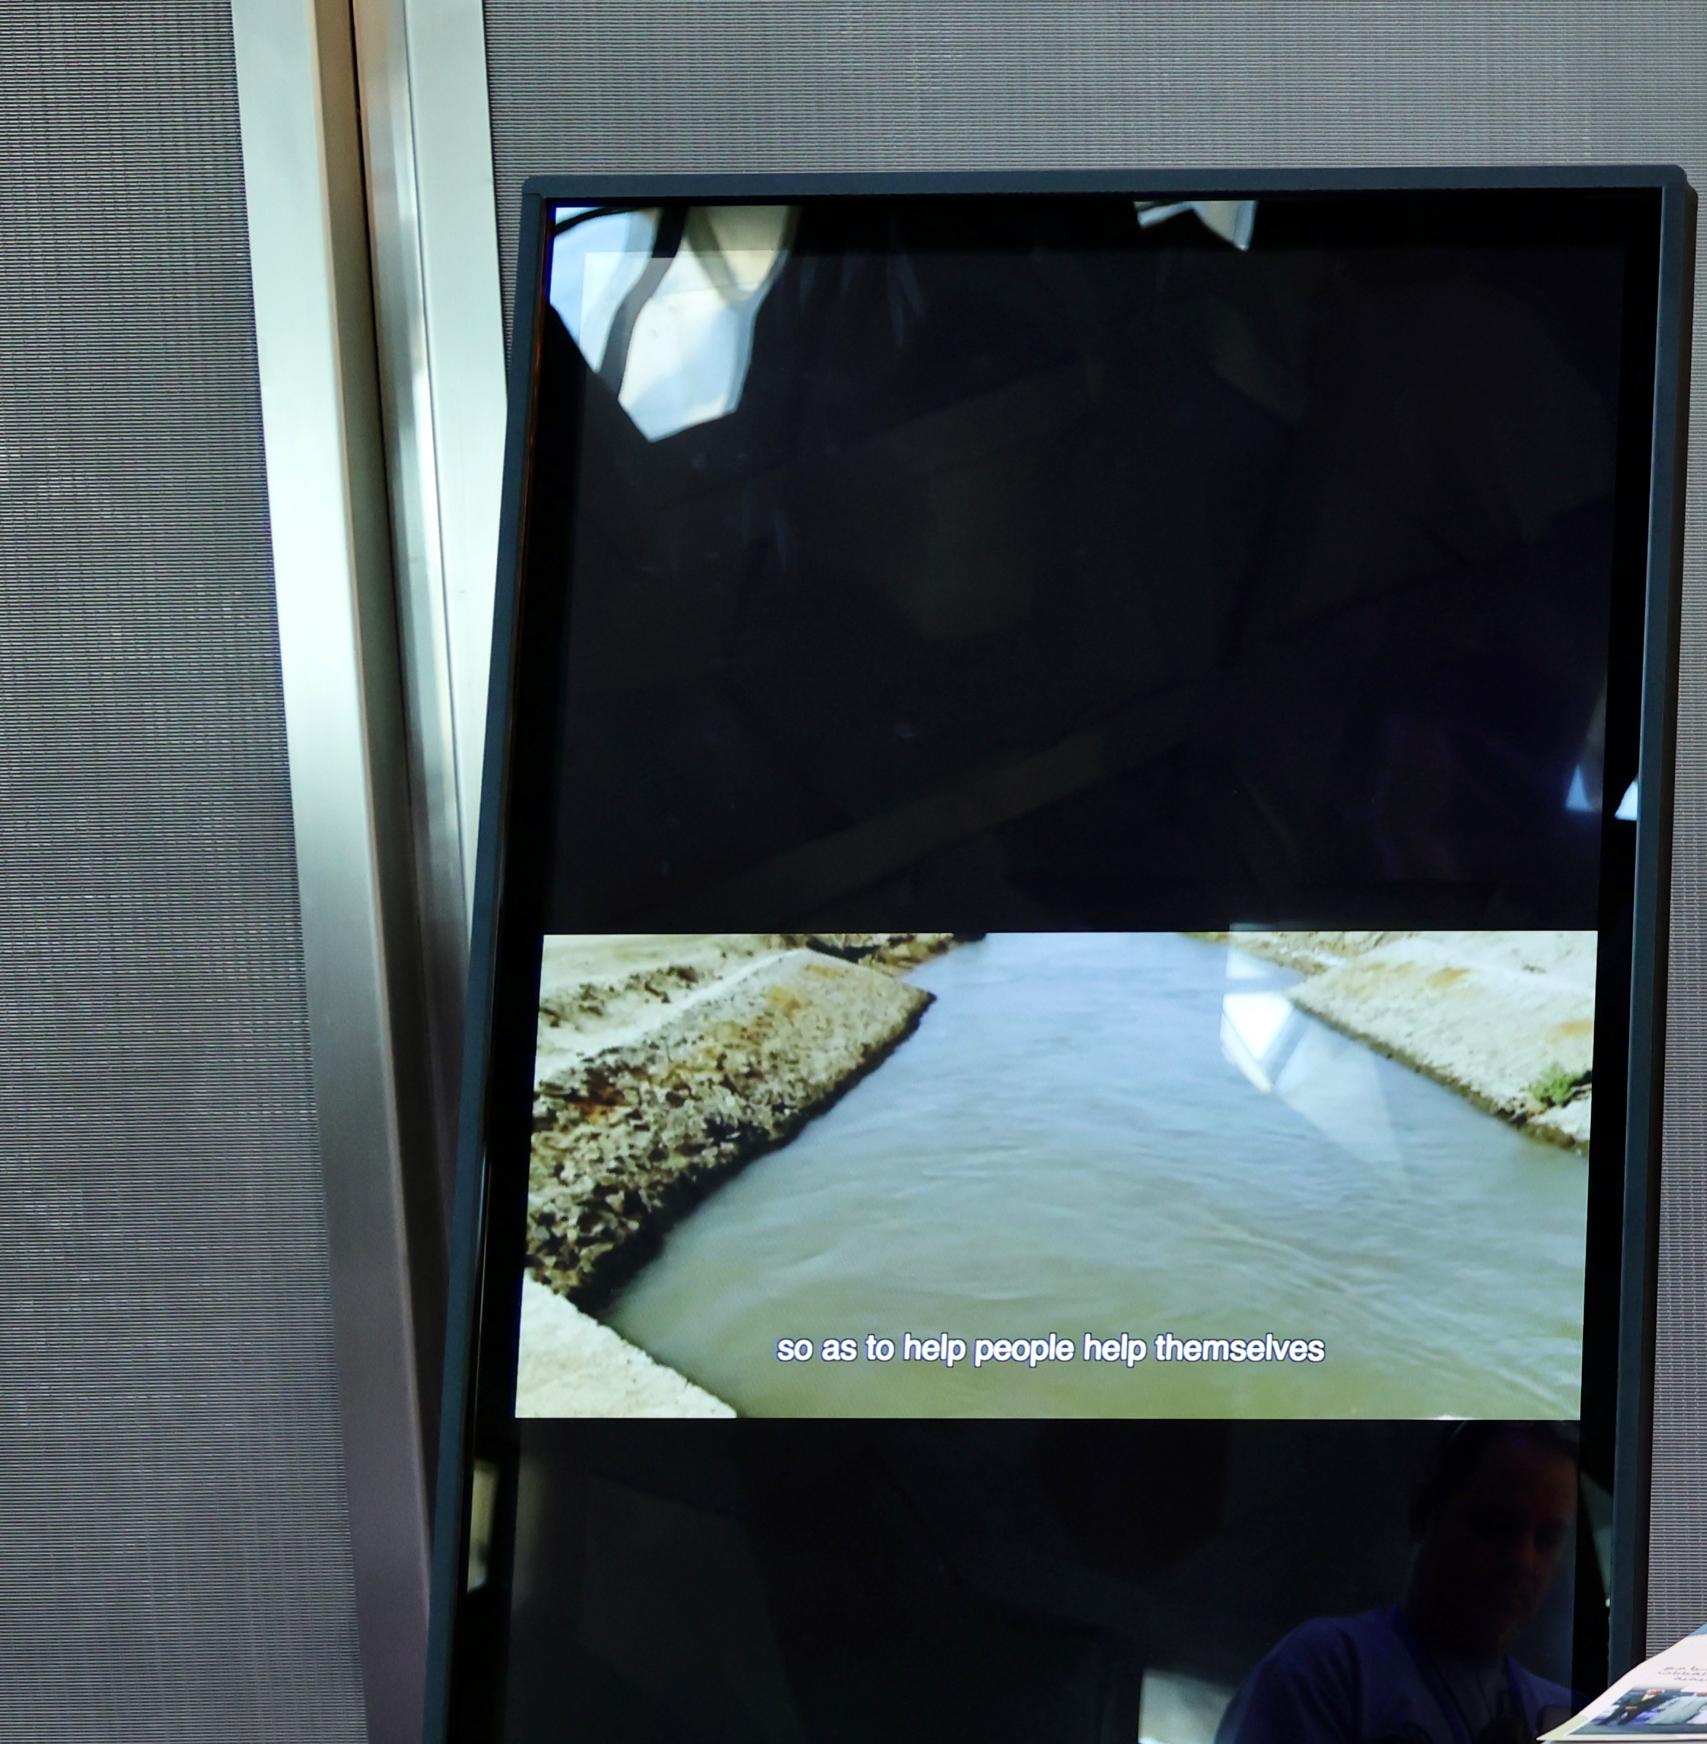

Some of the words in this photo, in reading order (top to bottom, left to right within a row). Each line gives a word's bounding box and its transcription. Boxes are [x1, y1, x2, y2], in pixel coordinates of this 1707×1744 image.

[777, 1338, 813, 1362] so
[821, 1338, 858, 1362] as
[866, 1335, 895, 1362] to
[903, 1333, 966, 1367] help
[974, 1333, 1075, 1367] people
[1083, 1333, 1147, 1367] help
[1155, 1333, 1325, 1362] themselves
